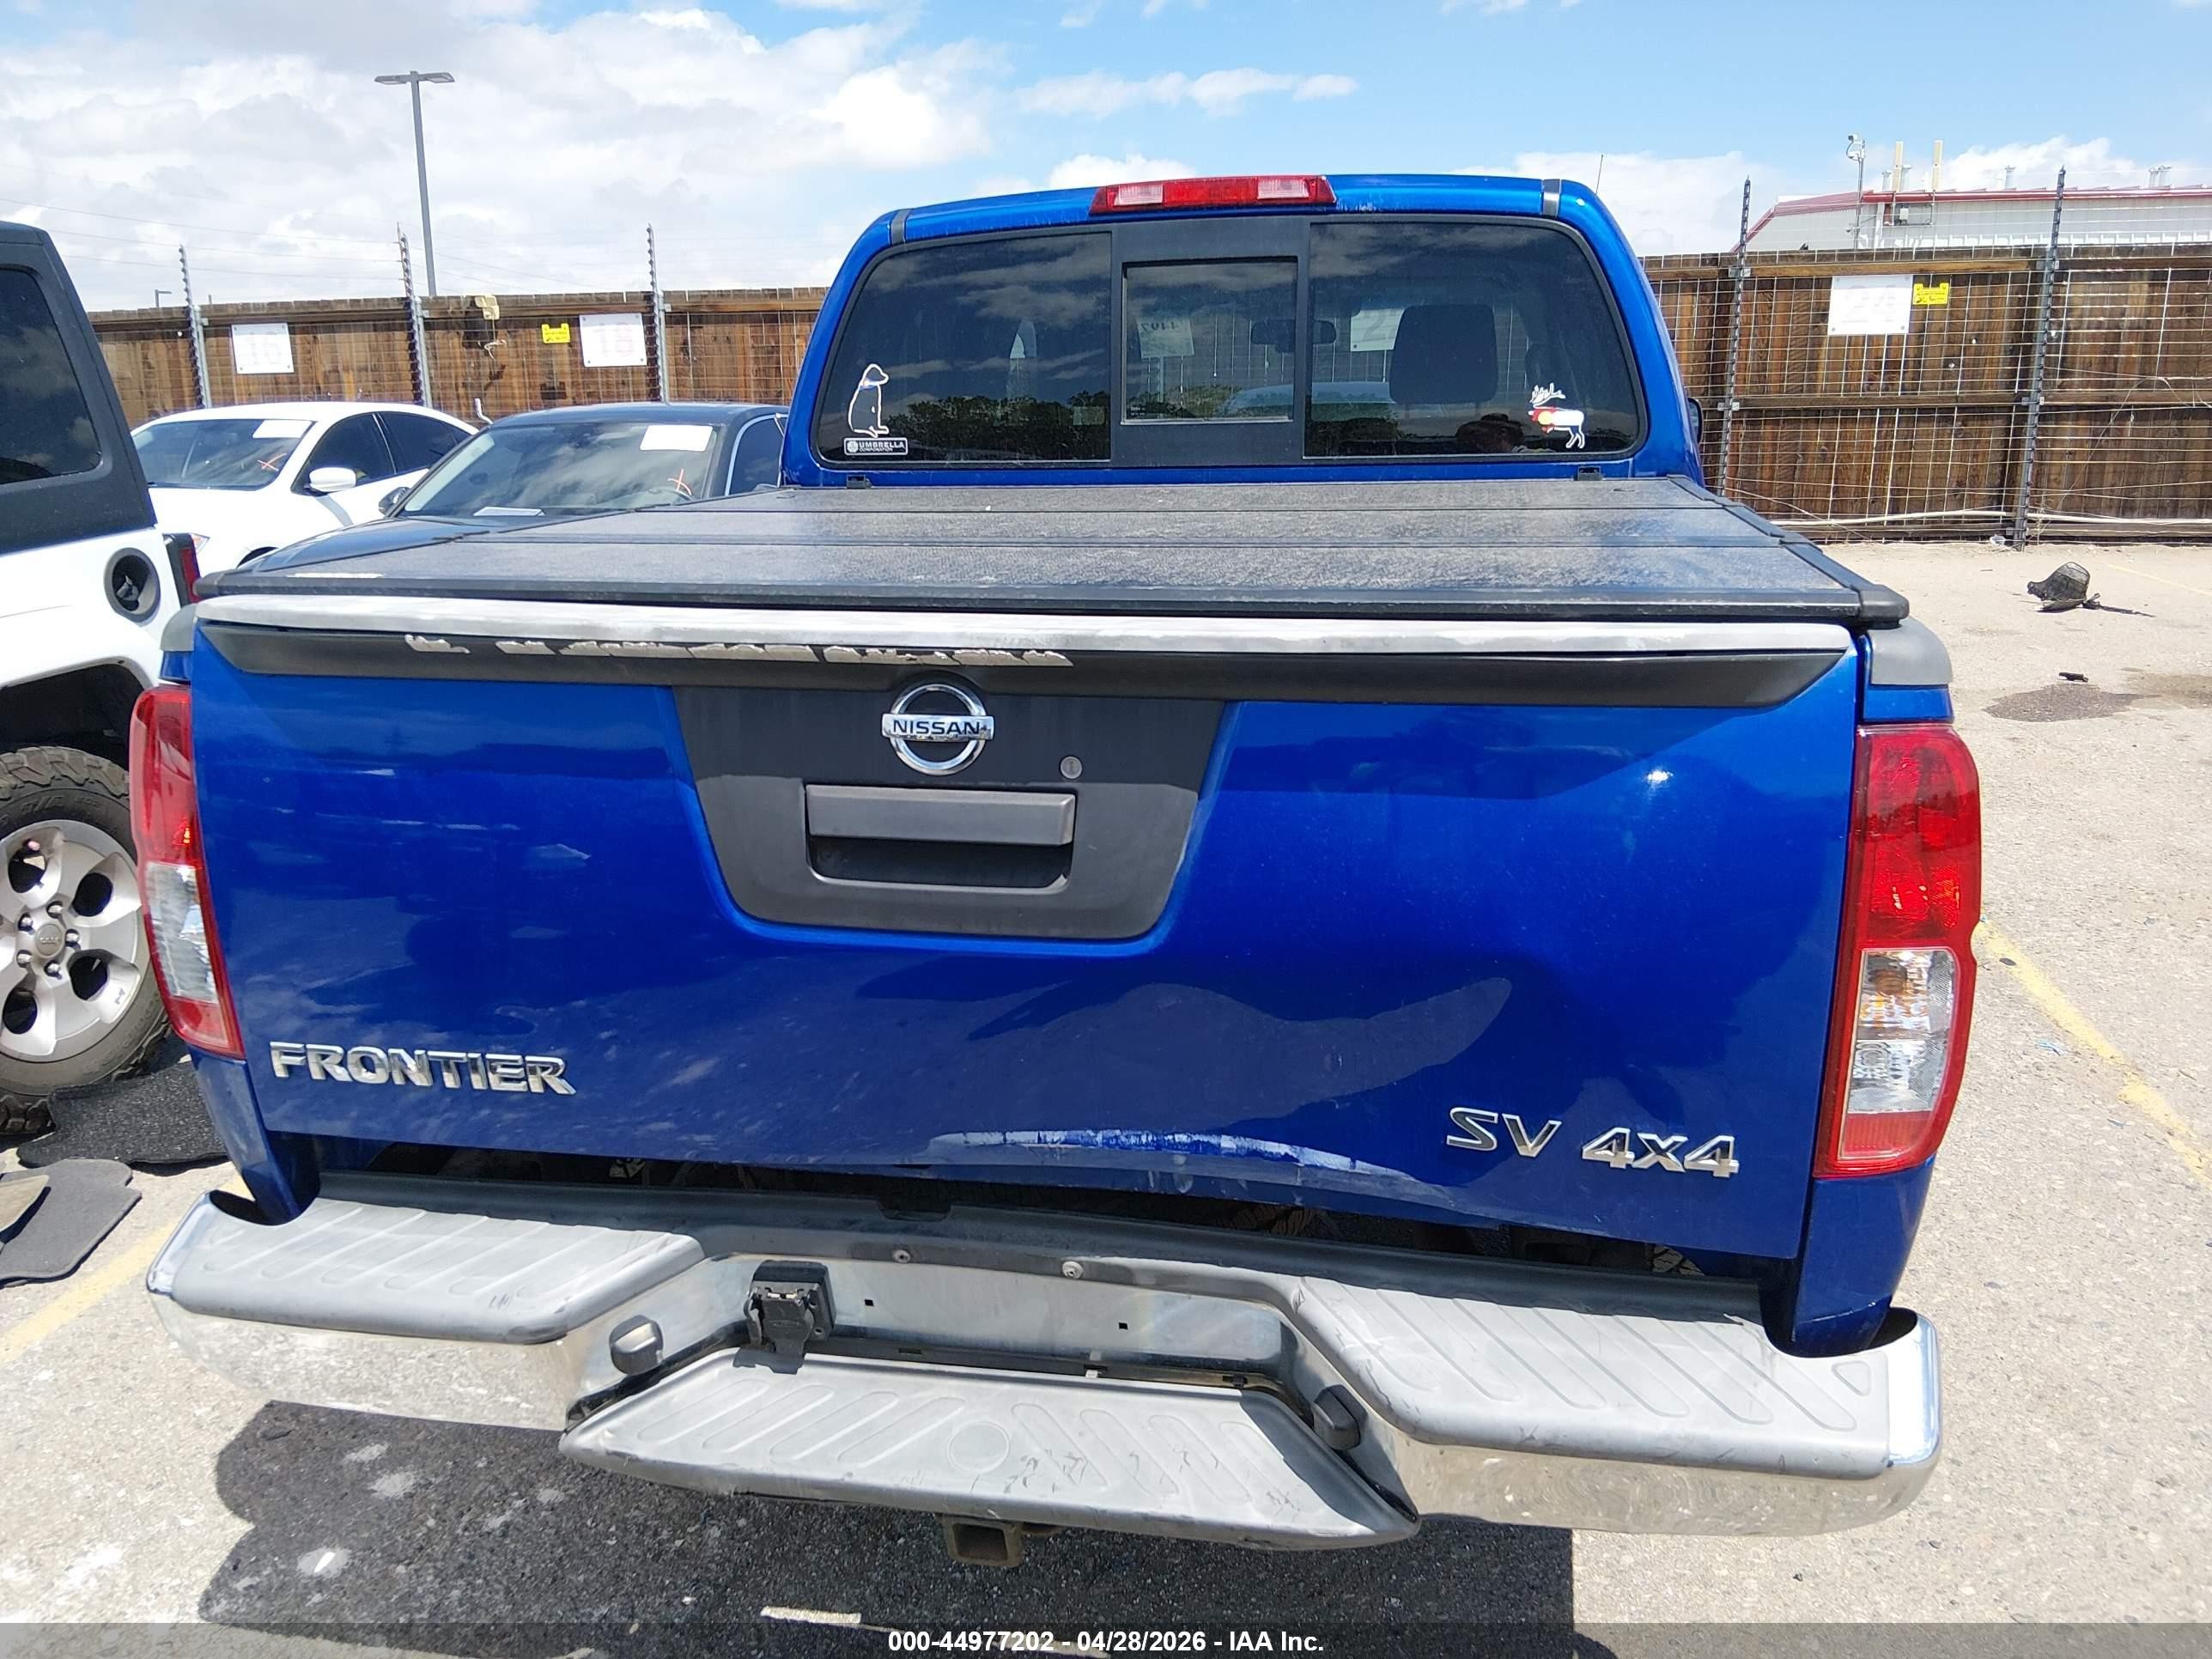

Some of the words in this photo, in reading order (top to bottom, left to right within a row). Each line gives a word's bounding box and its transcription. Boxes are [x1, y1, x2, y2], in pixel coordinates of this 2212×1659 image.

[859, 441, 905, 449] UMBRELLA
[893, 720, 981, 736] NISSAN
[269, 1041, 577, 1095] FRONTIER
[1446, 1107, 1563, 1158] SV
